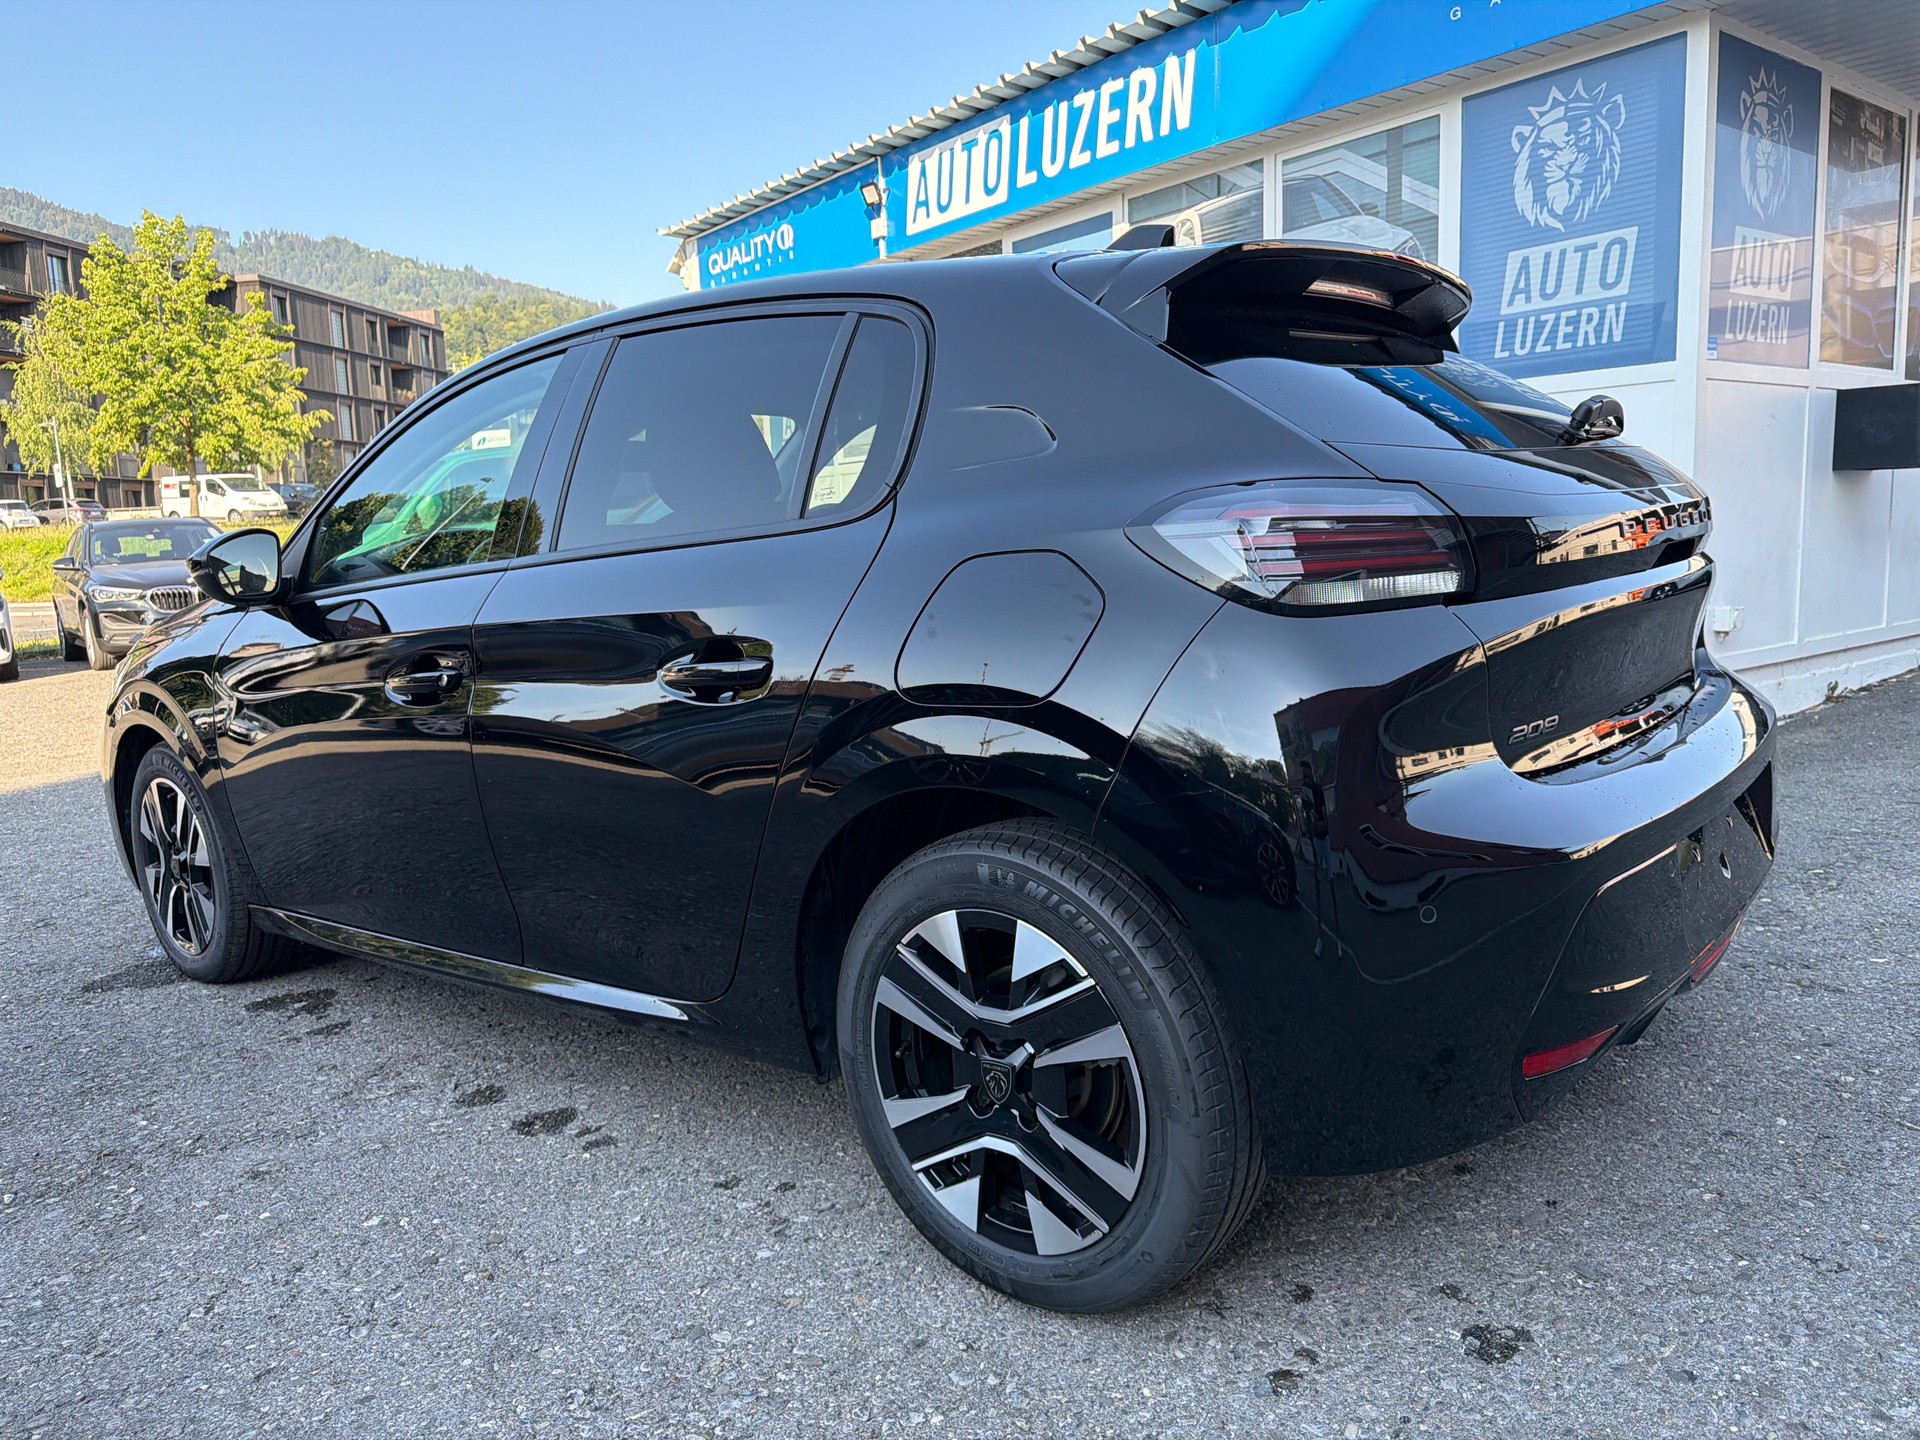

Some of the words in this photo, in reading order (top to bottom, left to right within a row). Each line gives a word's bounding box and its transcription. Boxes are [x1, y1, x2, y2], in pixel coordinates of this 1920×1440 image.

[912, 127, 1003, 224] AUTO
[1016, 48, 1196, 188] LUZERN
[708, 230, 776, 275] QUALITY
[1507, 237, 1629, 307] AUTO
[1733, 234, 1792, 293] AUTO
[1494, 302, 1627, 359] LUZERN
[1725, 299, 1790, 345] LUZERN
[163, 758, 200, 809] MICHELIN
[1023, 879, 1150, 1001] MICHELIN
